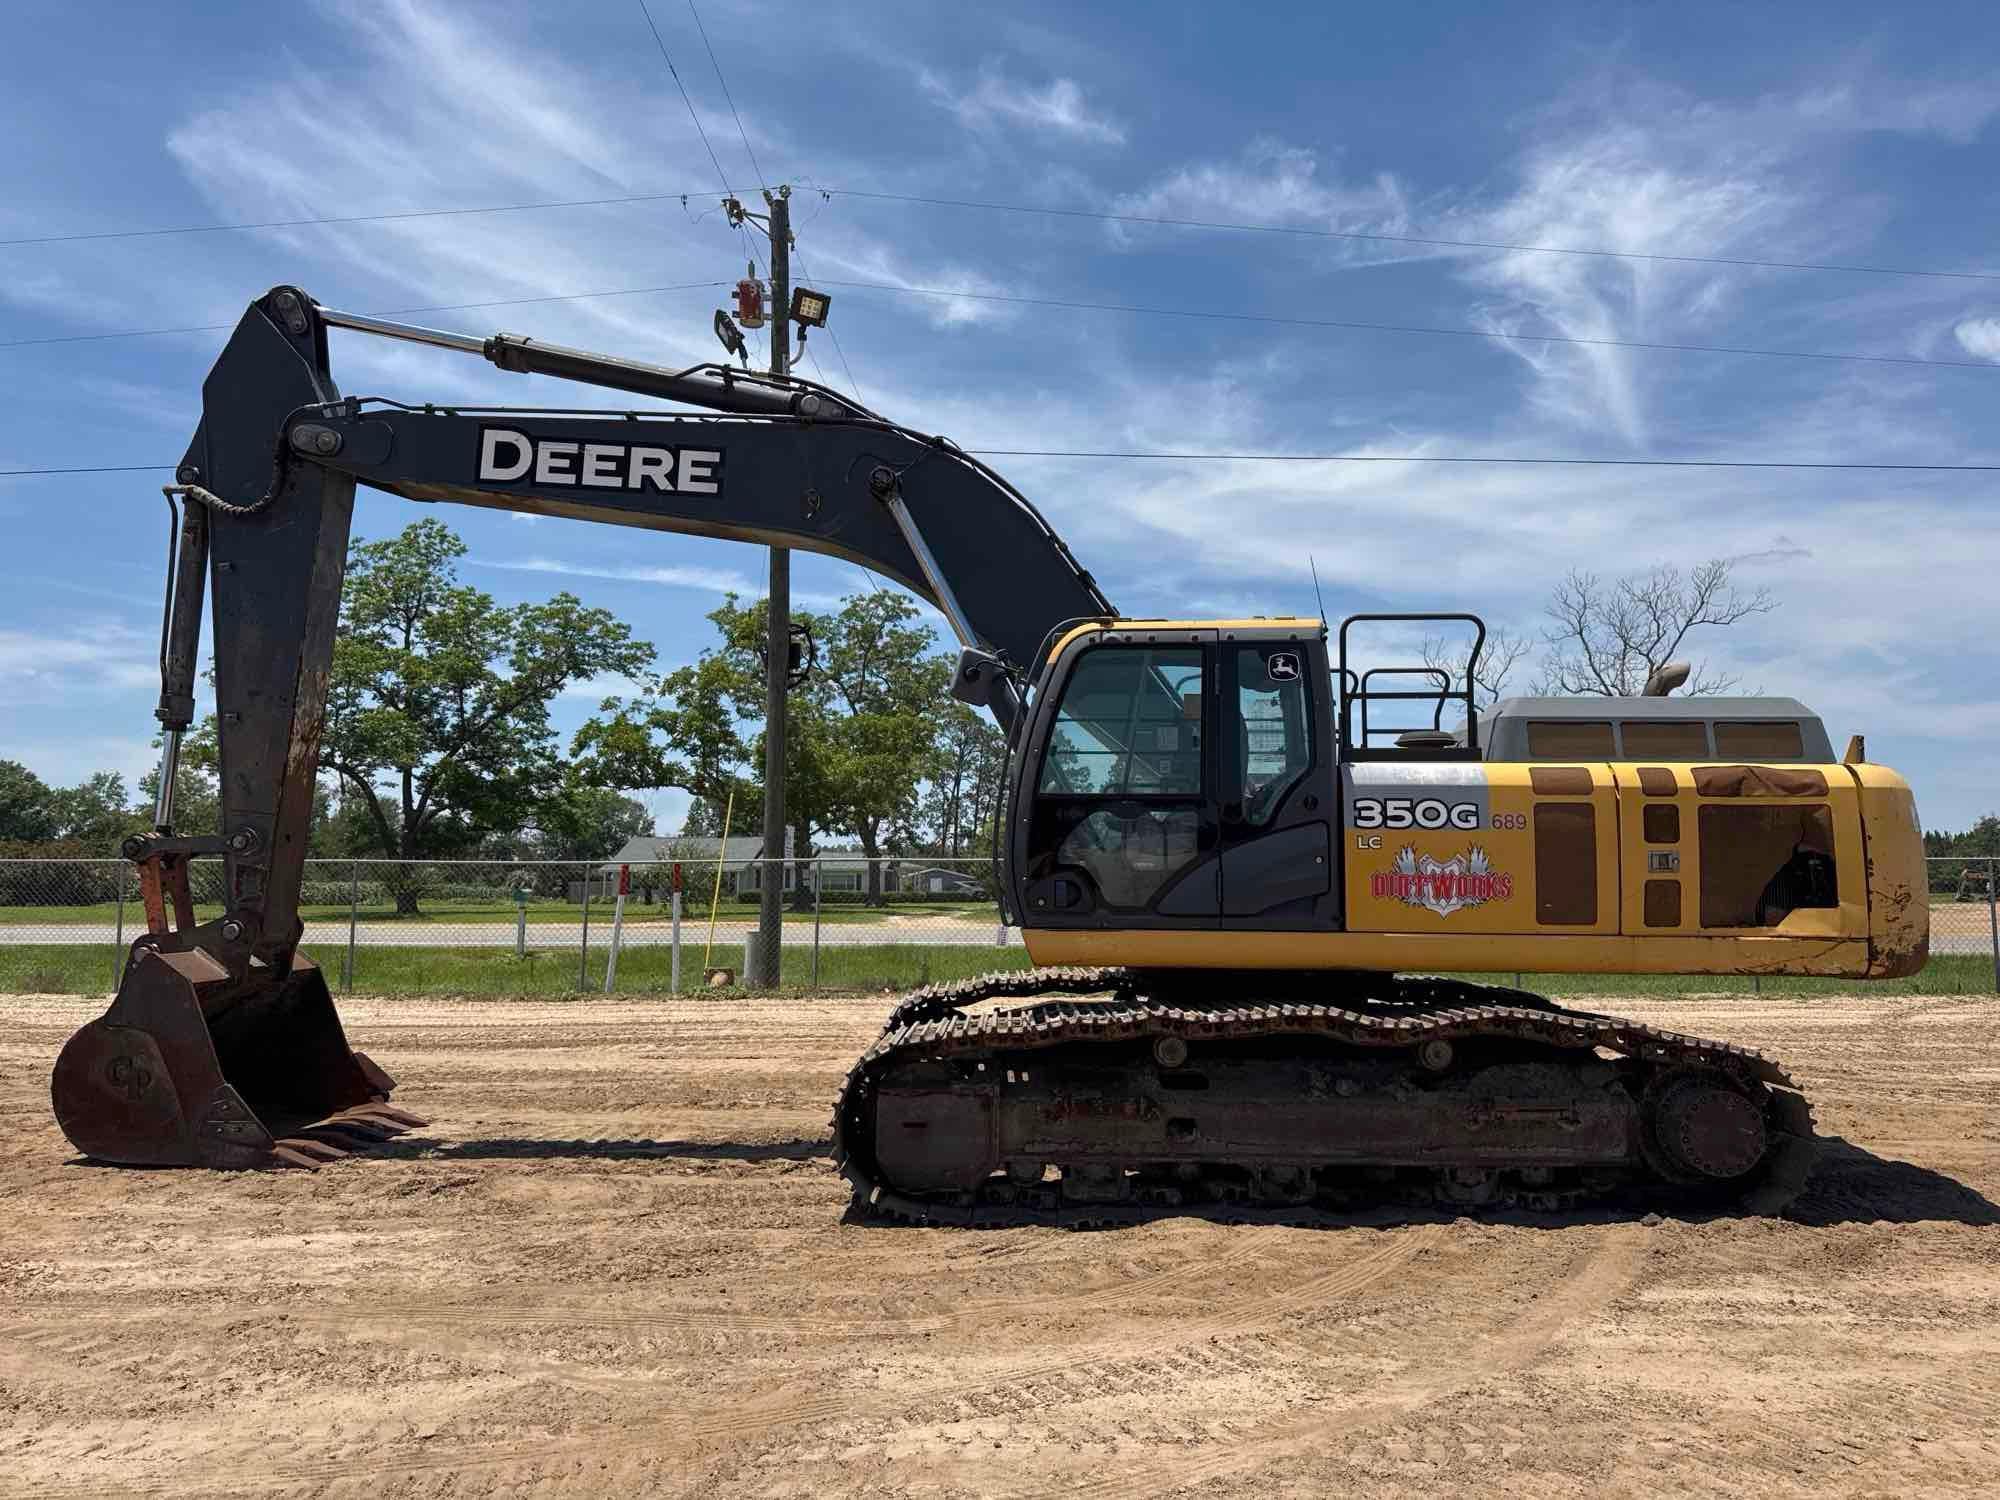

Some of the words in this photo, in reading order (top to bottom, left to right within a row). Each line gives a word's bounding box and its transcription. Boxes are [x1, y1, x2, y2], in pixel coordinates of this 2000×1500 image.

[480, 429, 720, 493] DEERE
[1353, 798, 1480, 830] 350G
[1491, 814, 1527, 829] 689
[1357, 836, 1382, 849] LC
